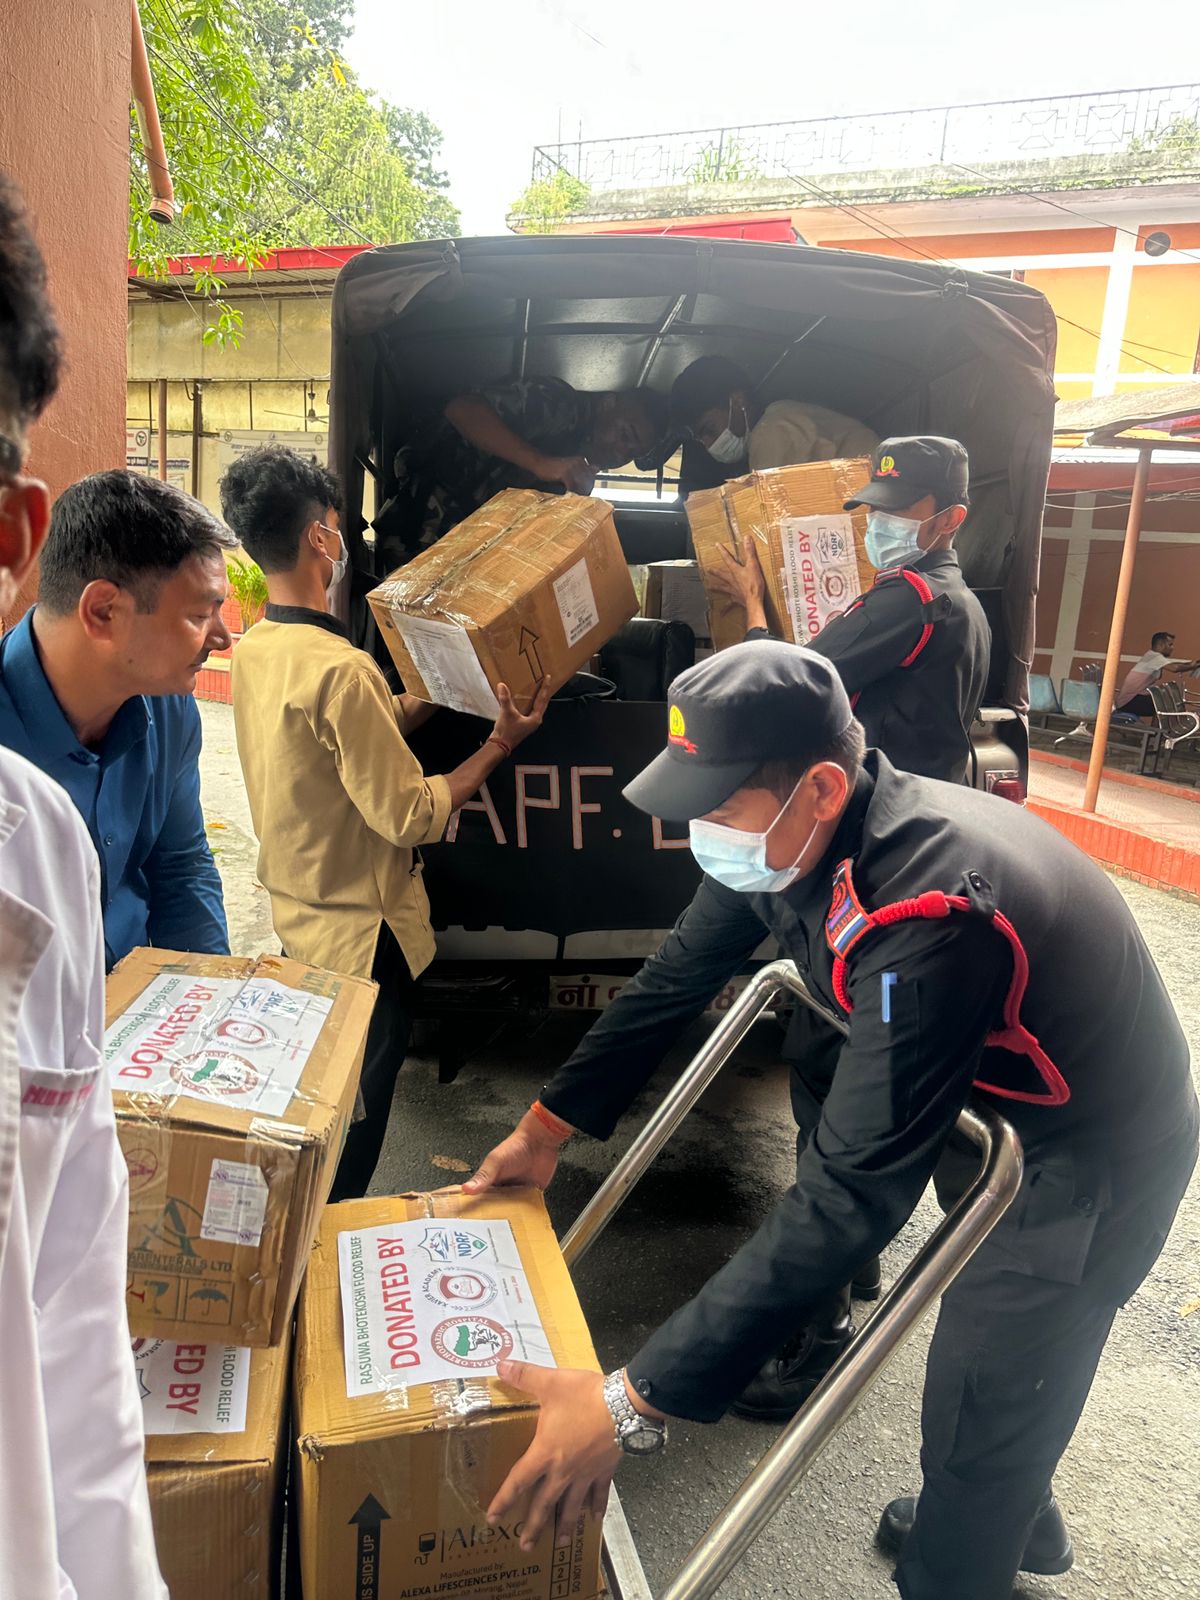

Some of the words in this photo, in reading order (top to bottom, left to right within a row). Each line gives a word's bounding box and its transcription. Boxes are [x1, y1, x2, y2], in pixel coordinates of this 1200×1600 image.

[798, 531, 811, 553] BY
[830, 531, 838, 556] NDRF
[801, 559, 820, 640] ONATED
[163, 978, 182, 996] RELIEF
[118, 1004, 203, 1079] DONATED
[182, 984, 218, 1001] BY
[351, 1236, 362, 1259] RELIEF
[377, 1237, 405, 1260] BY
[453, 1231, 472, 1257] NDRF
[211, 1260, 233, 1272] LTD
[354, 1260, 365, 1286] FLOOD
[422, 1268, 442, 1292] ACADEMY
[356, 1287, 369, 1339] BHOTEKOSHI
[380, 1262, 421, 1369] DONATED
[220, 1354, 236, 1387] FLOOD
[360, 1341, 373, 1384] RASUWA
[165, 1383, 201, 1415] BY
[216, 1390, 233, 1423] RELIEF
[363, 1534, 375, 1552] UP
[558, 1551, 565, 1562] 3
[362, 1555, 374, 1585] SIDE
[400, 1585, 431, 1599] ALEXA
[434, 1573, 498, 1593] LIFESCIENCES
[500, 1569, 520, 1581] PVT.
[521, 1564, 542, 1576] LTD.
[558, 1567, 564, 1578] 2
[556, 1584, 562, 1595] 1
